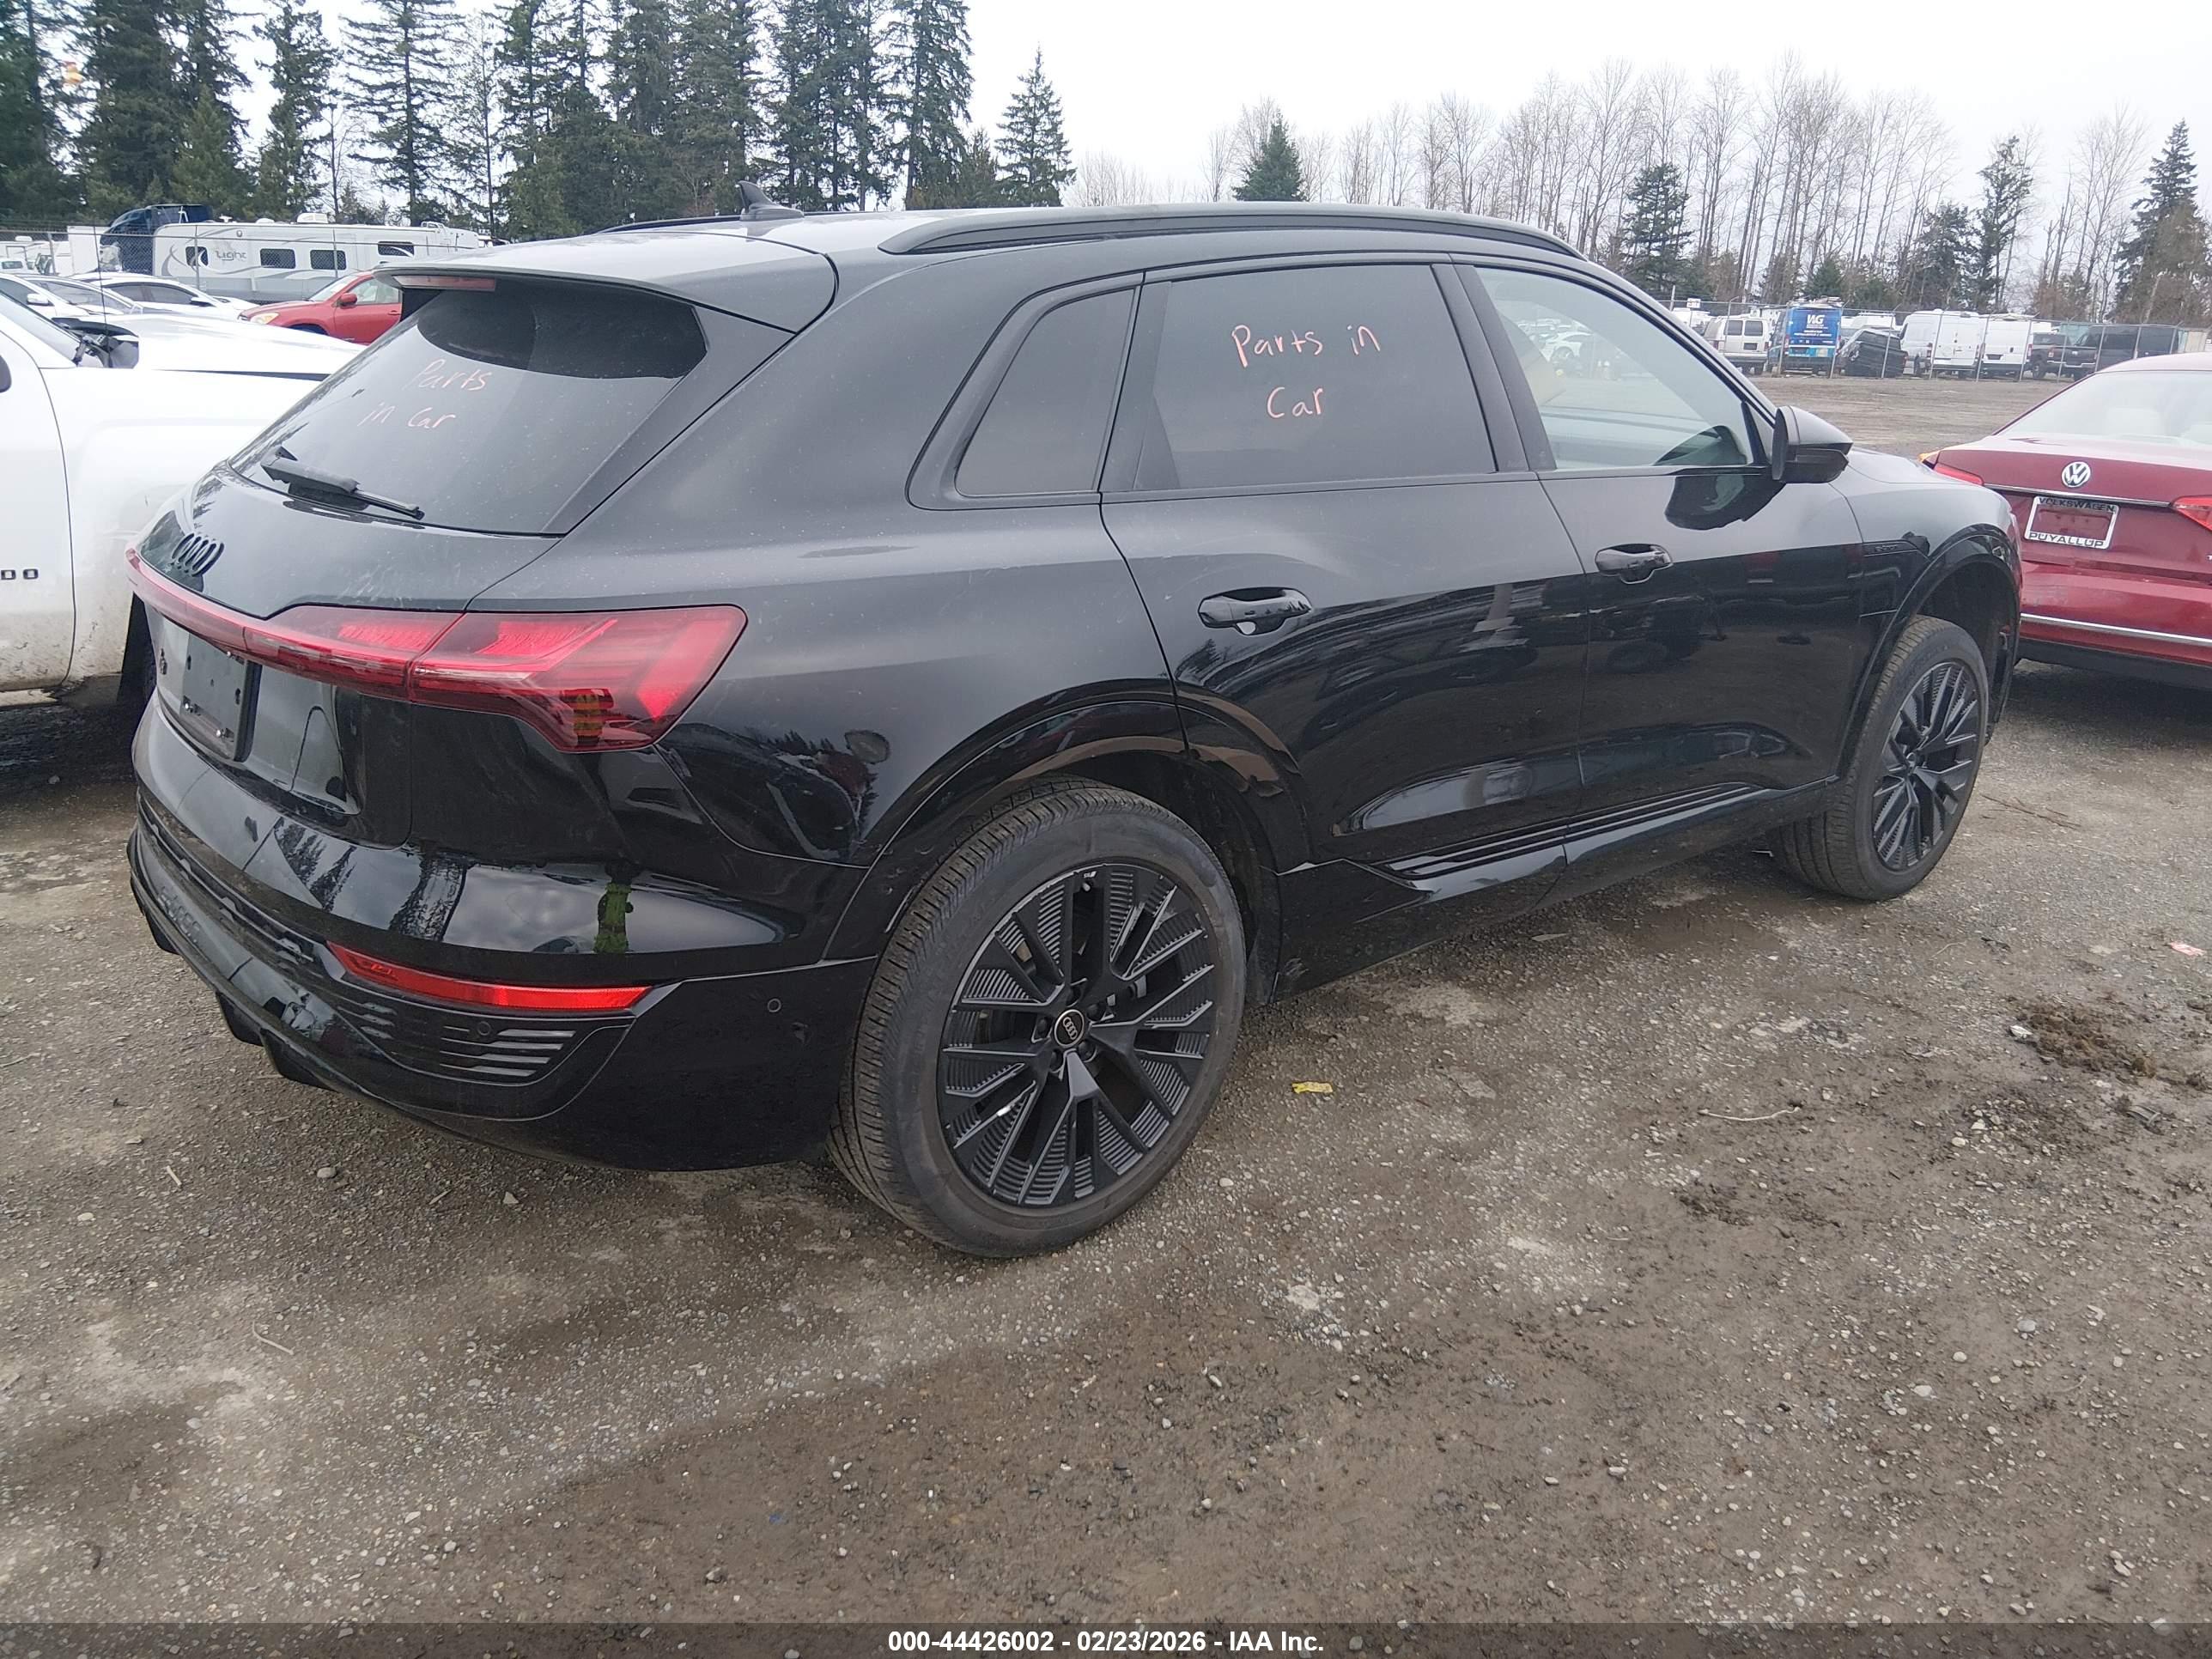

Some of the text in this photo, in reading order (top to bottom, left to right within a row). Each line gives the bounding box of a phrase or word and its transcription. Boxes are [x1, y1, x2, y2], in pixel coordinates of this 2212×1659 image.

[1231, 324, 1381, 368] Parts in
[402, 358, 493, 391] Parts
[356, 402, 456, 428] in Car
[1267, 386, 1323, 418] Car
[2039, 496, 2116, 513] VOLKSWAGEN
[2028, 532, 2105, 548] PUYALLUP
